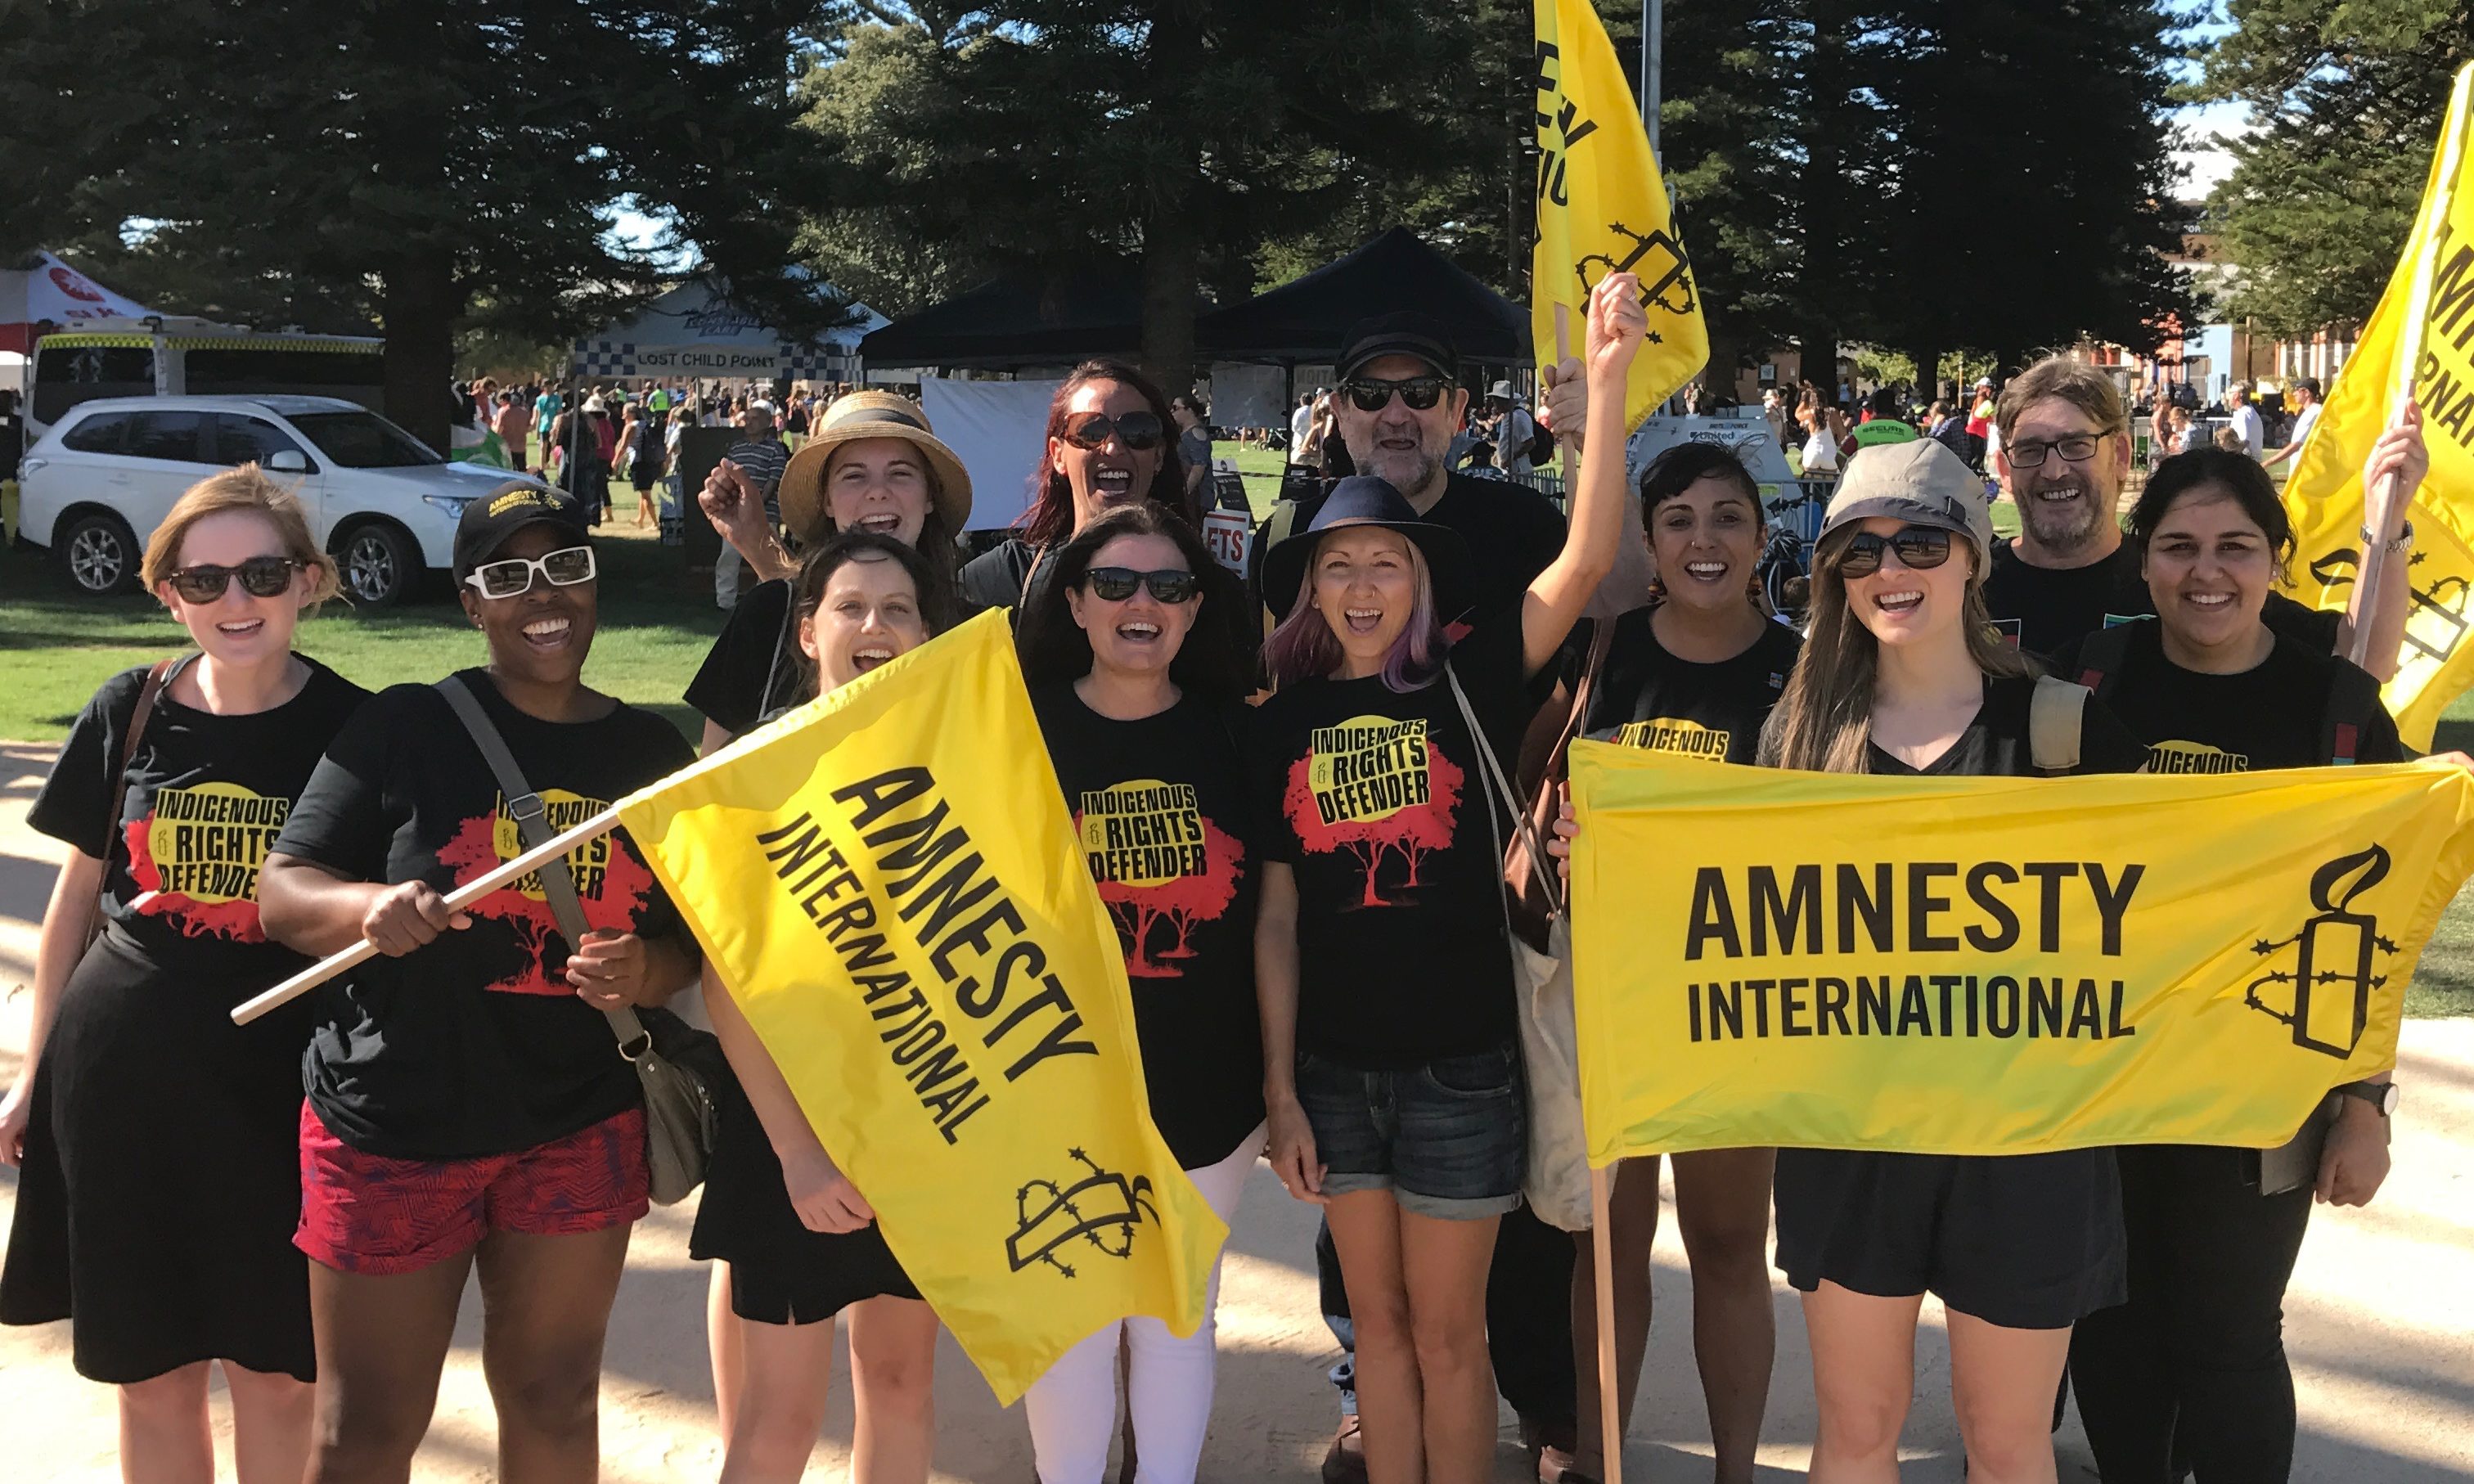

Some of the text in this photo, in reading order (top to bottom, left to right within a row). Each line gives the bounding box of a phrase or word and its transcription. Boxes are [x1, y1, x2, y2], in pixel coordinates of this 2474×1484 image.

[638, 353, 776, 368] LOST CHILD POINT
[488, 490, 538, 513] AMNESTY
[1314, 719, 1425, 755] INDIGENOUS
[1617, 725, 1728, 756] INDIGENOUS
[1333, 736, 1427, 787] RIGHTS
[156, 790, 288, 827] INDIGENOUS
[1083, 785, 1196, 816] INDIGENOUS
[1316, 770, 1429, 825] DEFENDER
[1104, 809, 1203, 850] RIGHTS
[157, 863, 259, 902] DEFENDE
[1088, 843, 1208, 884] DEFENDER
[830, 767, 1100, 1083] AMNESTY
[1685, 861, 2147, 961] AMNESTY
[757, 812, 992, 1146] INTERNATIONAL
[1688, 974, 2136, 1042] INTERNATIONAL
